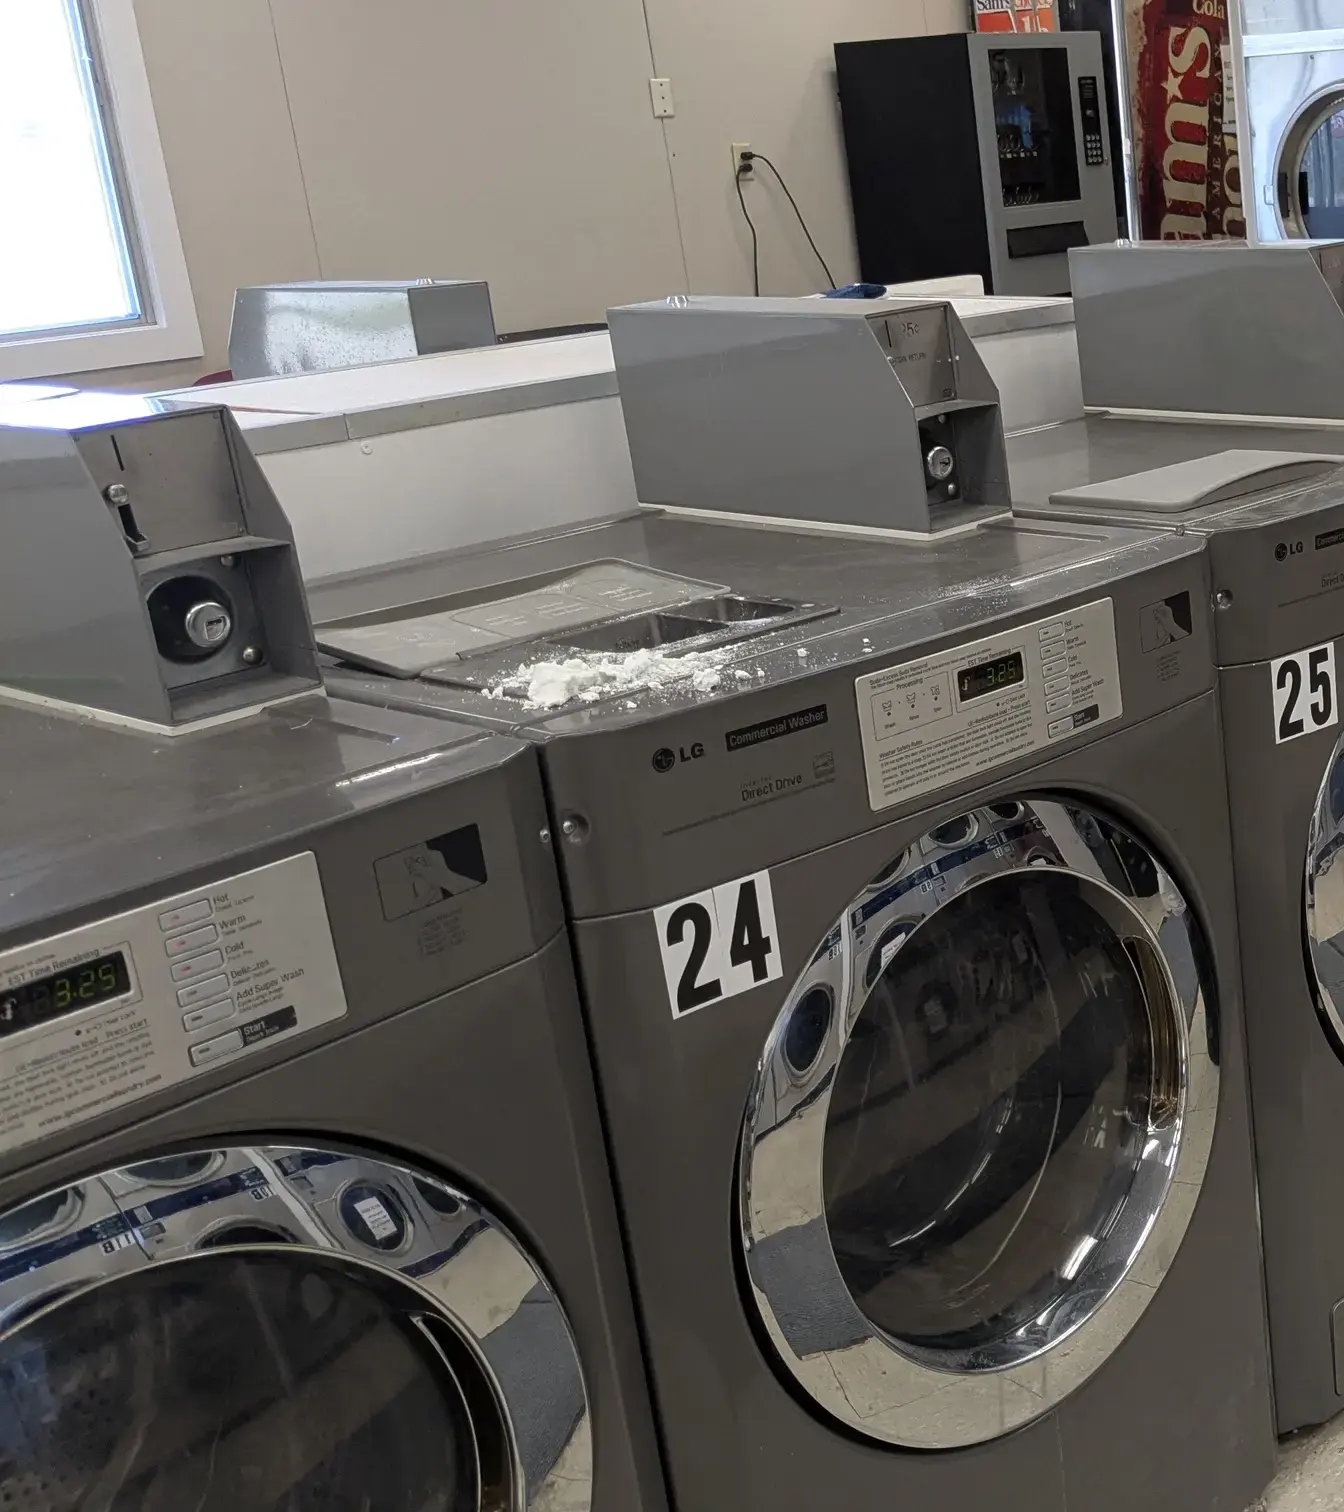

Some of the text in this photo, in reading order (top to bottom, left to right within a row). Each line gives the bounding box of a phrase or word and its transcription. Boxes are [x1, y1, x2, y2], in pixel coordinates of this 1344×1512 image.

[1289, 541, 1304, 555] LG
[896, 676, 923, 691] Processing
[1277, 647, 1332, 740] 25
[729, 710, 824, 747] Commercial Washer
[679, 743, 705, 762] LG
[741, 774, 802, 801] Direct Drive
[219, 913, 245, 930] Warm
[225, 941, 243, 954] Cold
[666, 879, 772, 1013] 24
[236, 986, 253, 1000] Add
[254, 977, 279, 993] Super
[280, 967, 304, 982] Wash
[244, 1020, 265, 1035] Start
